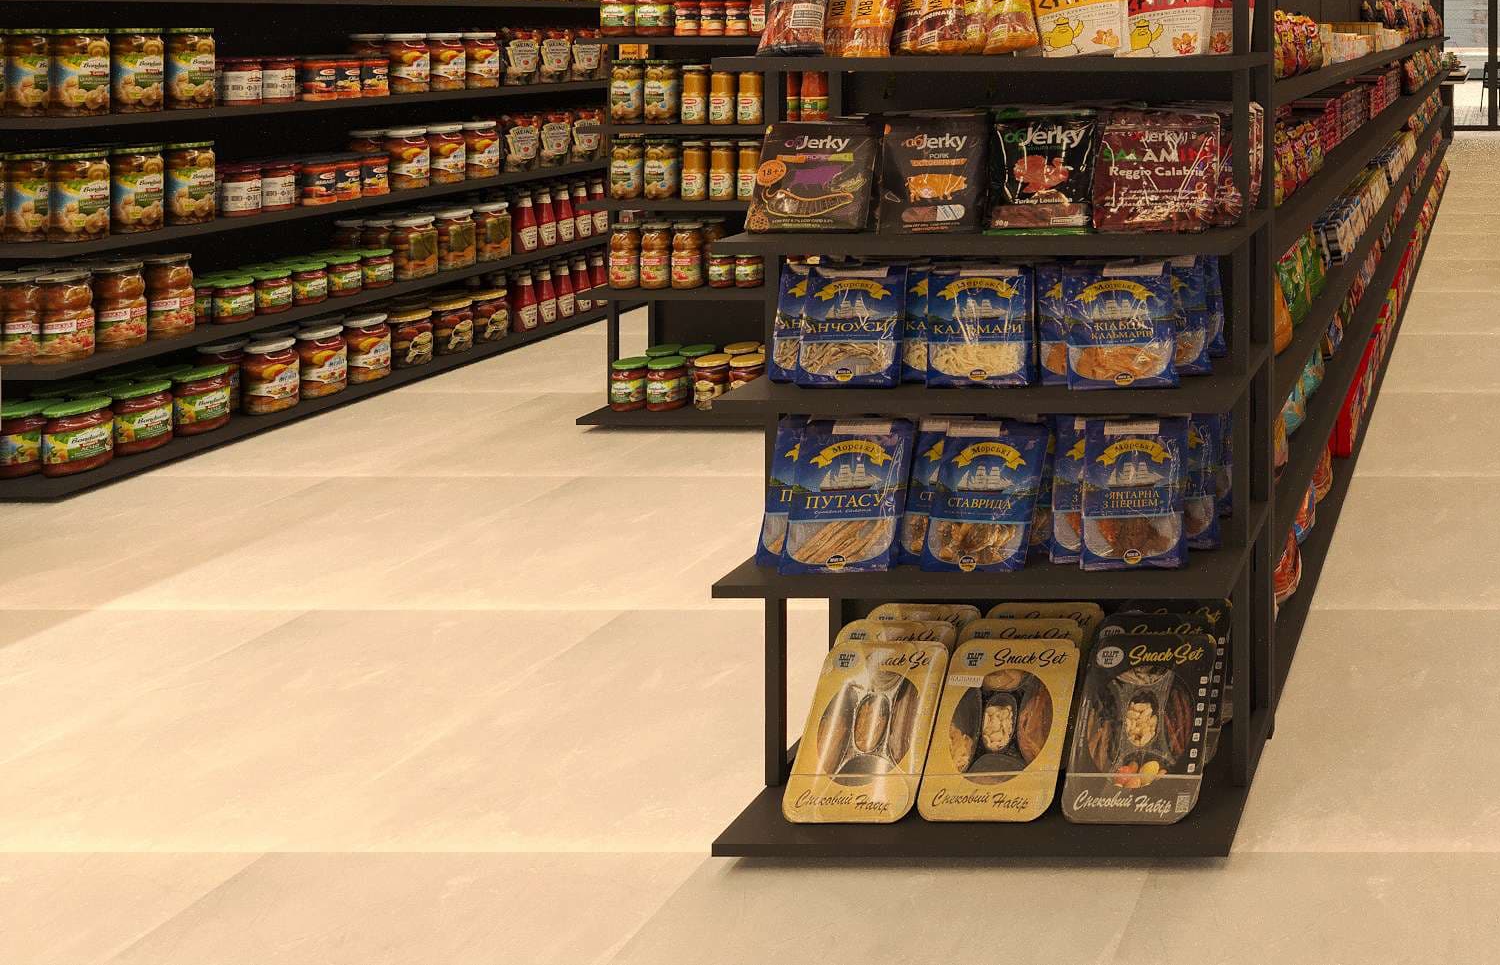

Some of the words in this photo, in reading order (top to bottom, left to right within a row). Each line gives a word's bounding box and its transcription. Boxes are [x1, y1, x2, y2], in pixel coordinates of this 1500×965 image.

[1109, 166, 1152, 180] Reggio
[1154, 167, 1204, 177] Calabria
[805, 493, 885, 509] ПУТАСУ
[908, 651, 933, 670] Se
[994, 648, 1039, 668] Snack
[1038, 649, 1070, 668] Set
[1129, 645, 1174, 665] Snack
[1174, 643, 1205, 665] Set
